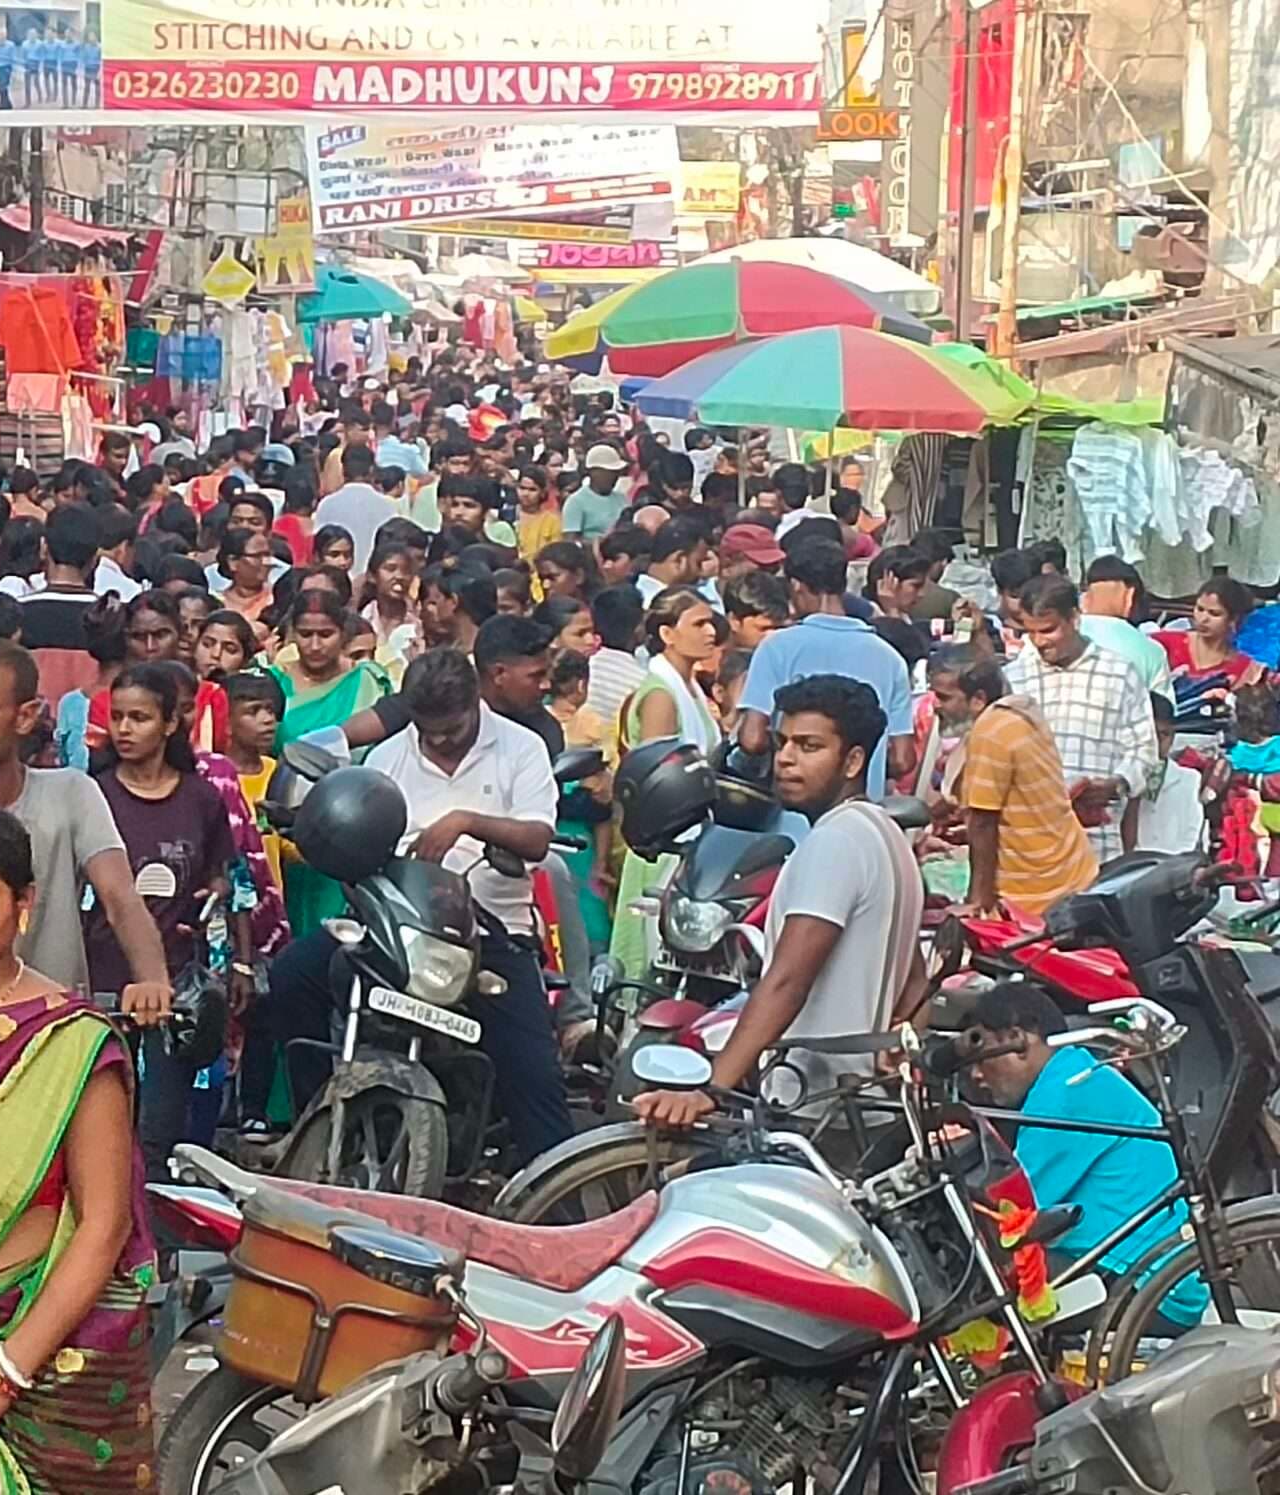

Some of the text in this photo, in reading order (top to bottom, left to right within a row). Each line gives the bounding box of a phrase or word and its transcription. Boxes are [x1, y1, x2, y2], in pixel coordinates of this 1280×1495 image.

[153, 23, 328, 51] STITCHING
[340, 28, 413, 50] AND
[112, 71, 300, 99] 0326230230
[311, 65, 615, 105] MADHUKUNJ
[816, 111, 898, 138] LOOK
[319, 127, 363, 150] SALE
[324, 201, 401, 226] RANI
